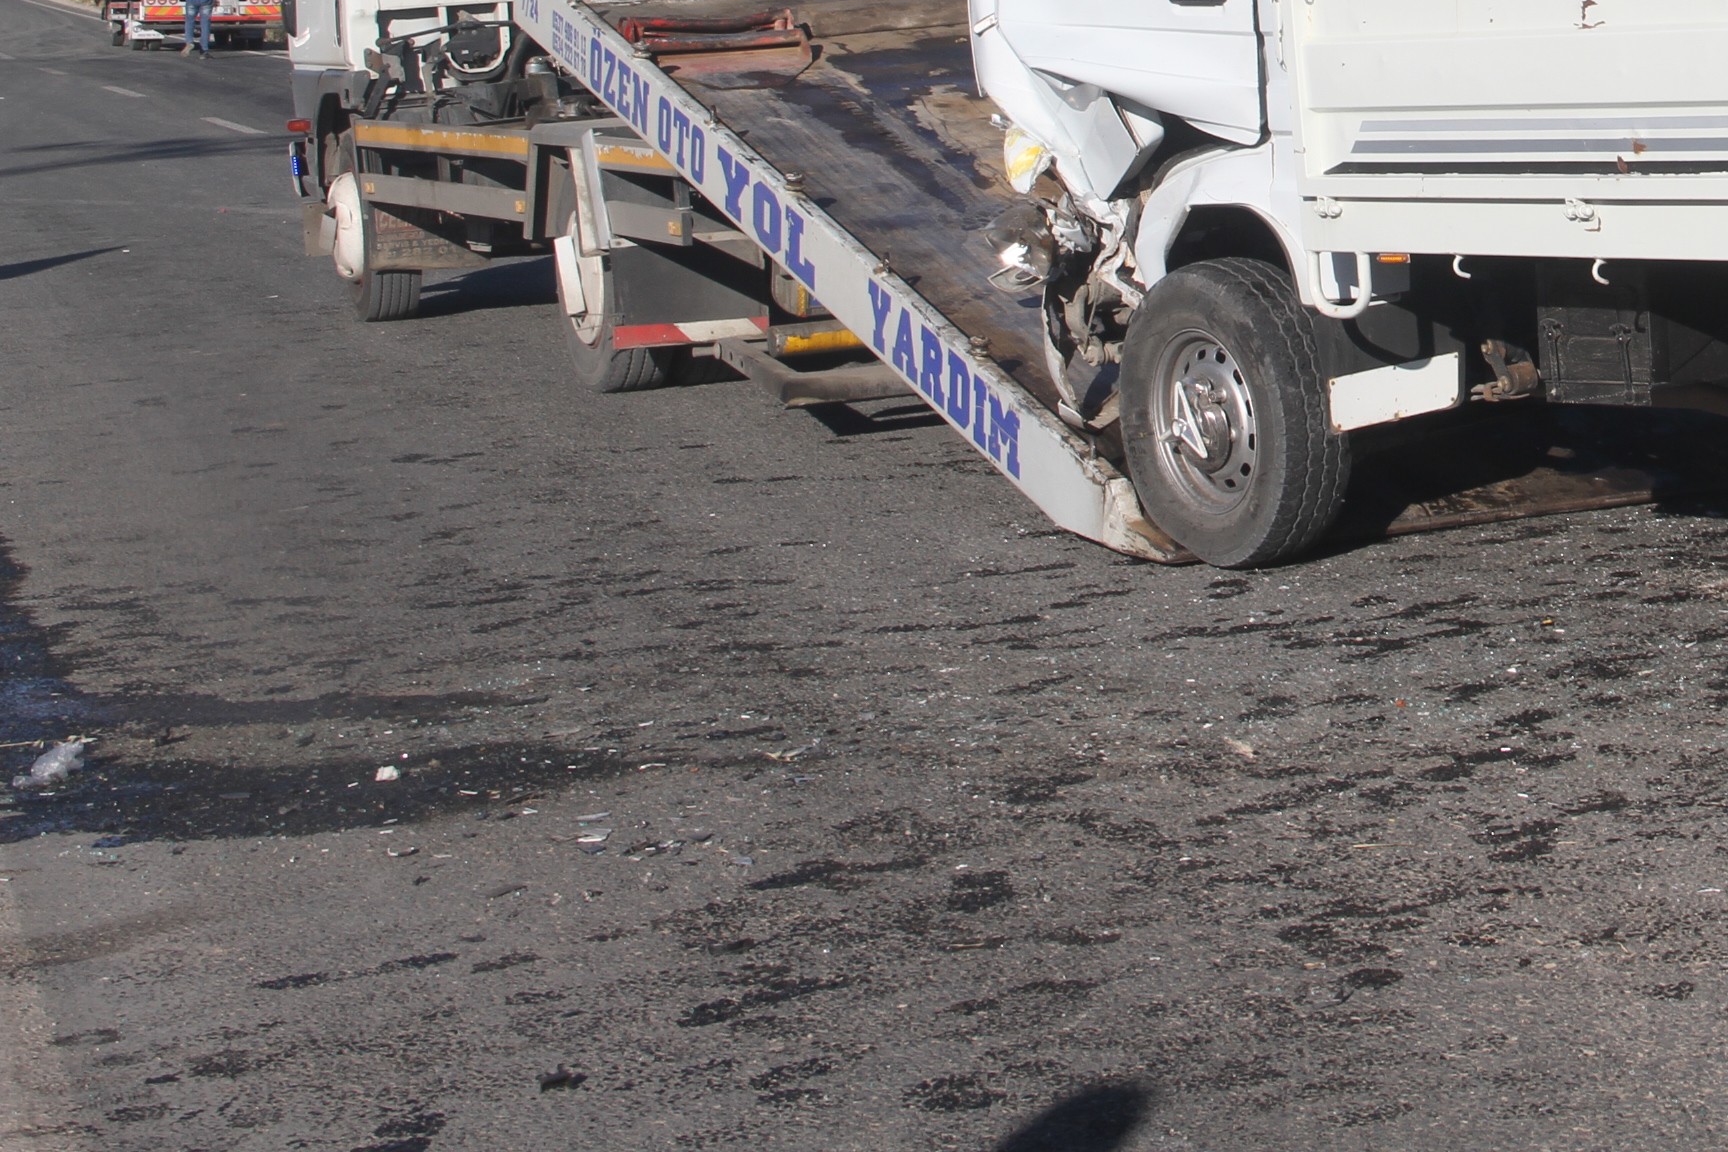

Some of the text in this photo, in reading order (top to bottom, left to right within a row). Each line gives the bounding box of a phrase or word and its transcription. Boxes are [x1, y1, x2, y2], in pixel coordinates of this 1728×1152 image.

[590, 27, 1020, 480] ÖZEN OTO YOL YARDIM
